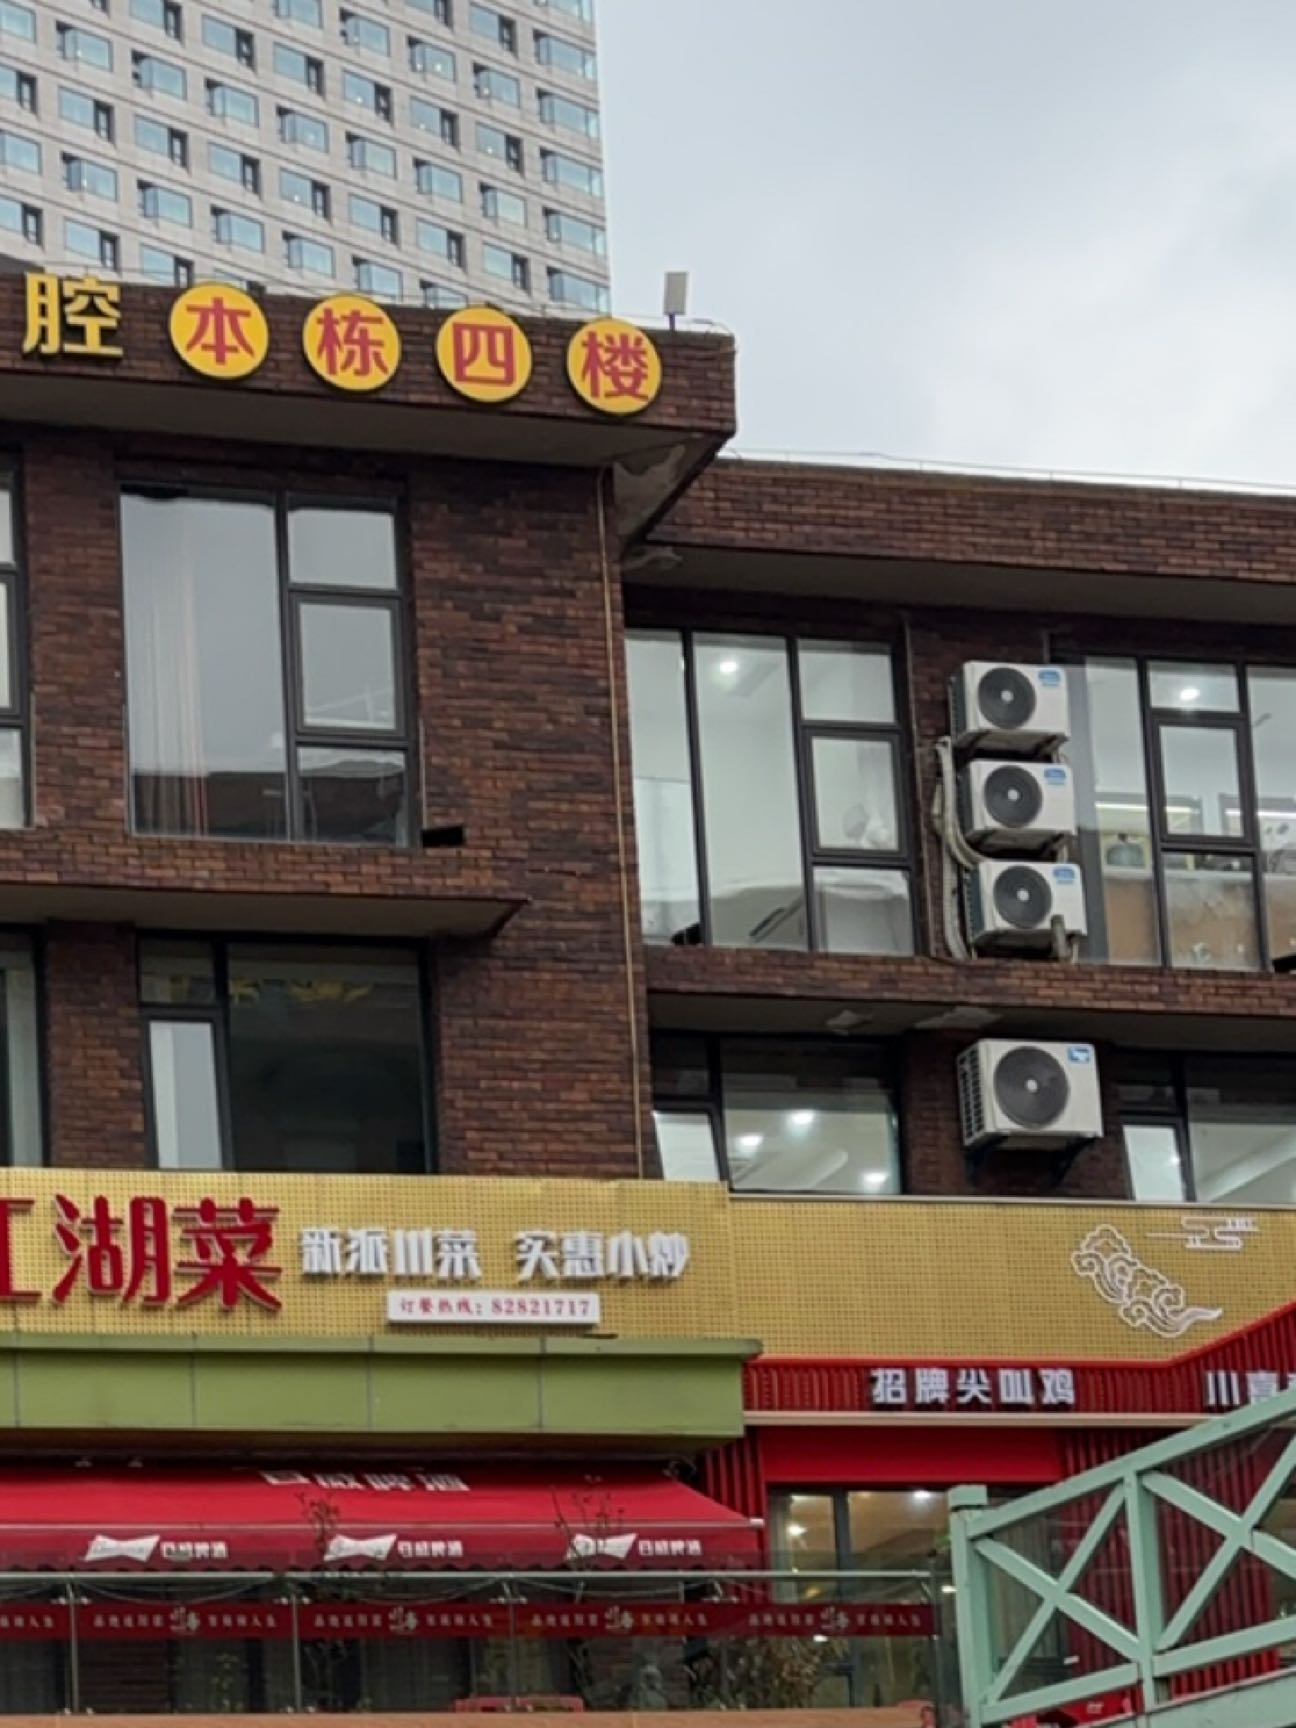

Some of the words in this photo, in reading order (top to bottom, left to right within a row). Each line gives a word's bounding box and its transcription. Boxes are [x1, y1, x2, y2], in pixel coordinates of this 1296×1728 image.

[184, 296, 652, 402] 本栋四楼
[300, 1228, 481, 1282] 新派川菜
[514, 1230, 691, 1284] 实惠小炒
[870, 1368, 1075, 1407] 招牌尖叫鸡
